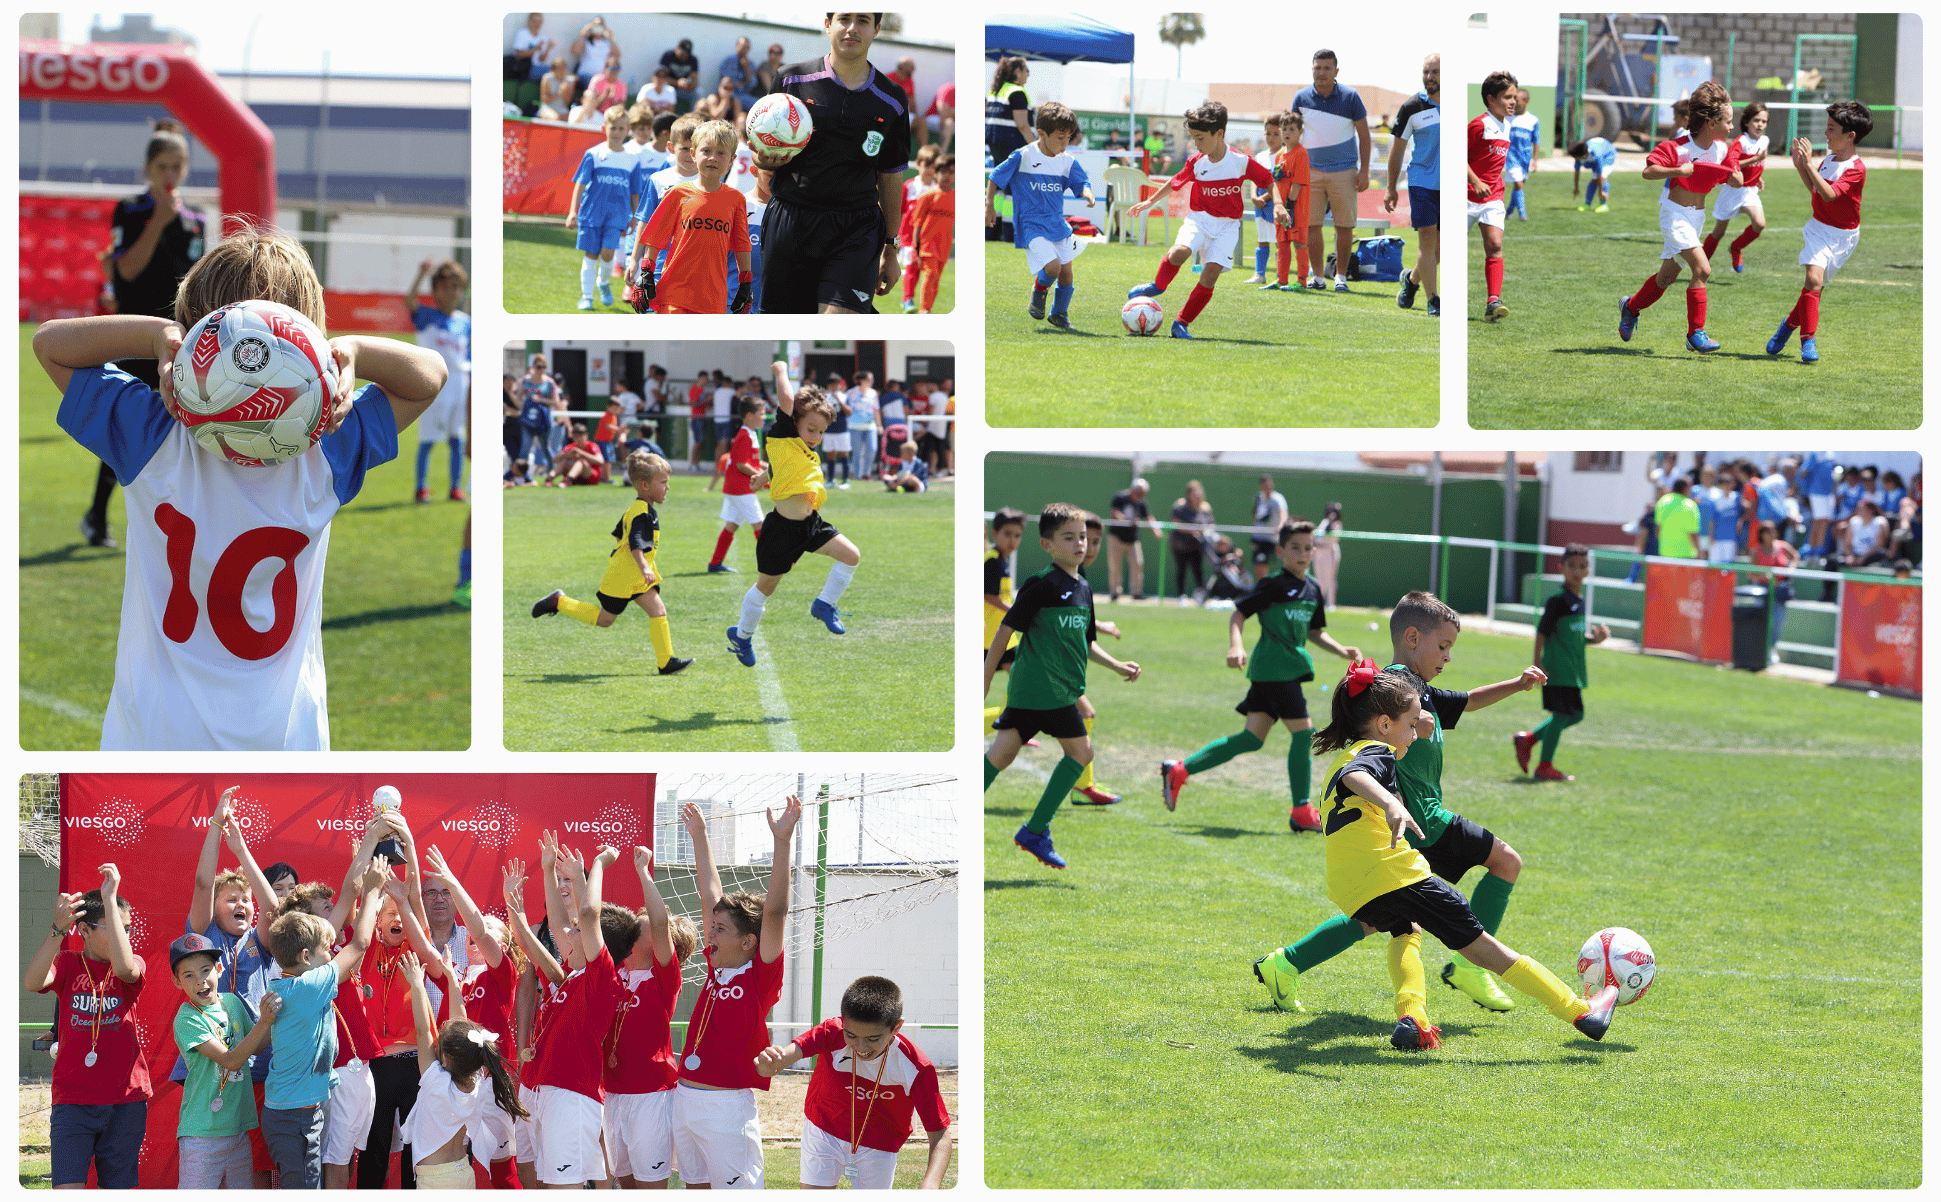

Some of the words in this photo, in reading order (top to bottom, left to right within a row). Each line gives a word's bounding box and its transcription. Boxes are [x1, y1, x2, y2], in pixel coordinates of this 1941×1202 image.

[737, 156, 749, 175] 5
[154, 503, 310, 661] 10
[72, 995, 119, 1014] SURFNG
